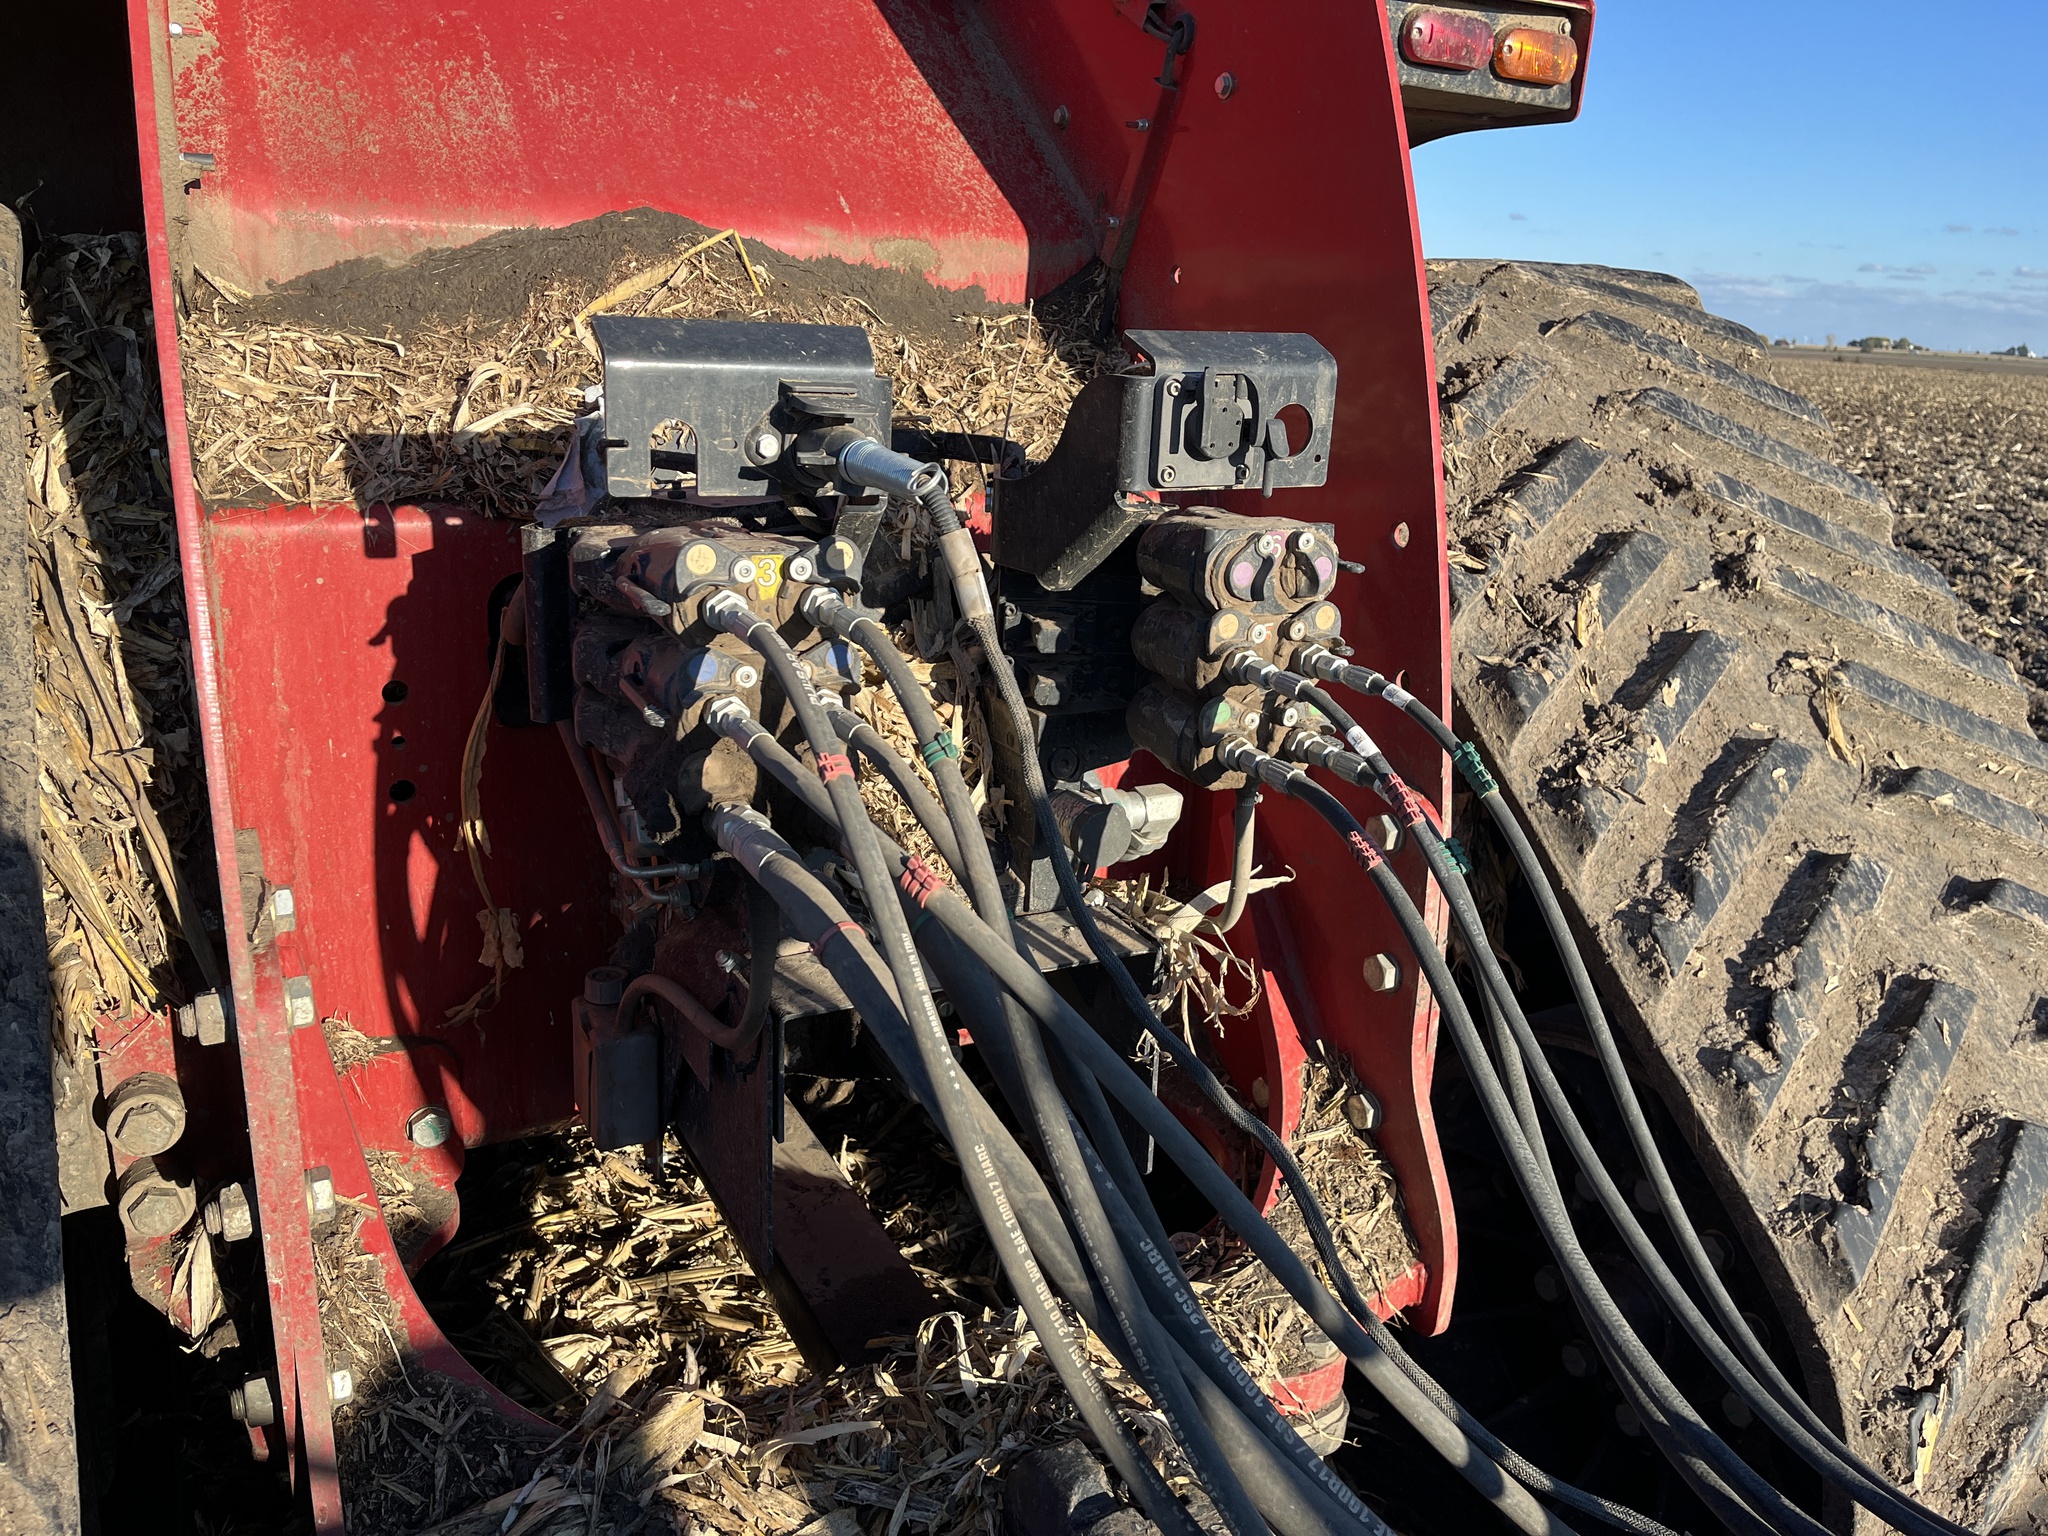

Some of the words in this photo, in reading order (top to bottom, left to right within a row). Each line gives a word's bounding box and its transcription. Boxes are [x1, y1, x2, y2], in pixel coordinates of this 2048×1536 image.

[758, 558, 777, 587] 3
[786, 652, 821, 707] PULSAR
[900, 932, 915, 954] ITALY
[908, 953, 919, 966] IN
[912, 965, 928, 991] MADE
[923, 994, 943, 1037] ABRASION
[974, 1142, 996, 1179] HARC
[988, 1180, 1016, 1231] 100R17
[1010, 1229, 1028, 1255] SAE
[1024, 1259, 1042, 1284] WP
[1138, 1237, 1178, 1288] HARC
[1035, 1283, 1052, 1311] BAR
[1174, 1288, 1204, 1325] 2SC
[1048, 1311, 1067, 1337] 210
[1069, 1346, 1088, 1368] PSI
[1101, 1275, 1119, 1303] 3/8"
[1116, 1311, 1138, 1346] 3000
[1130, 1347, 1150, 1372] PSI
[1150, 1383, 1168, 1410] 210
[1081, 1369, 1106, 1402] 3000
[1211, 1338, 1265, 1408] 100R16
[1265, 1412, 1298, 1445] SAE
[1308, 1458, 1370, 1523] 100R17
